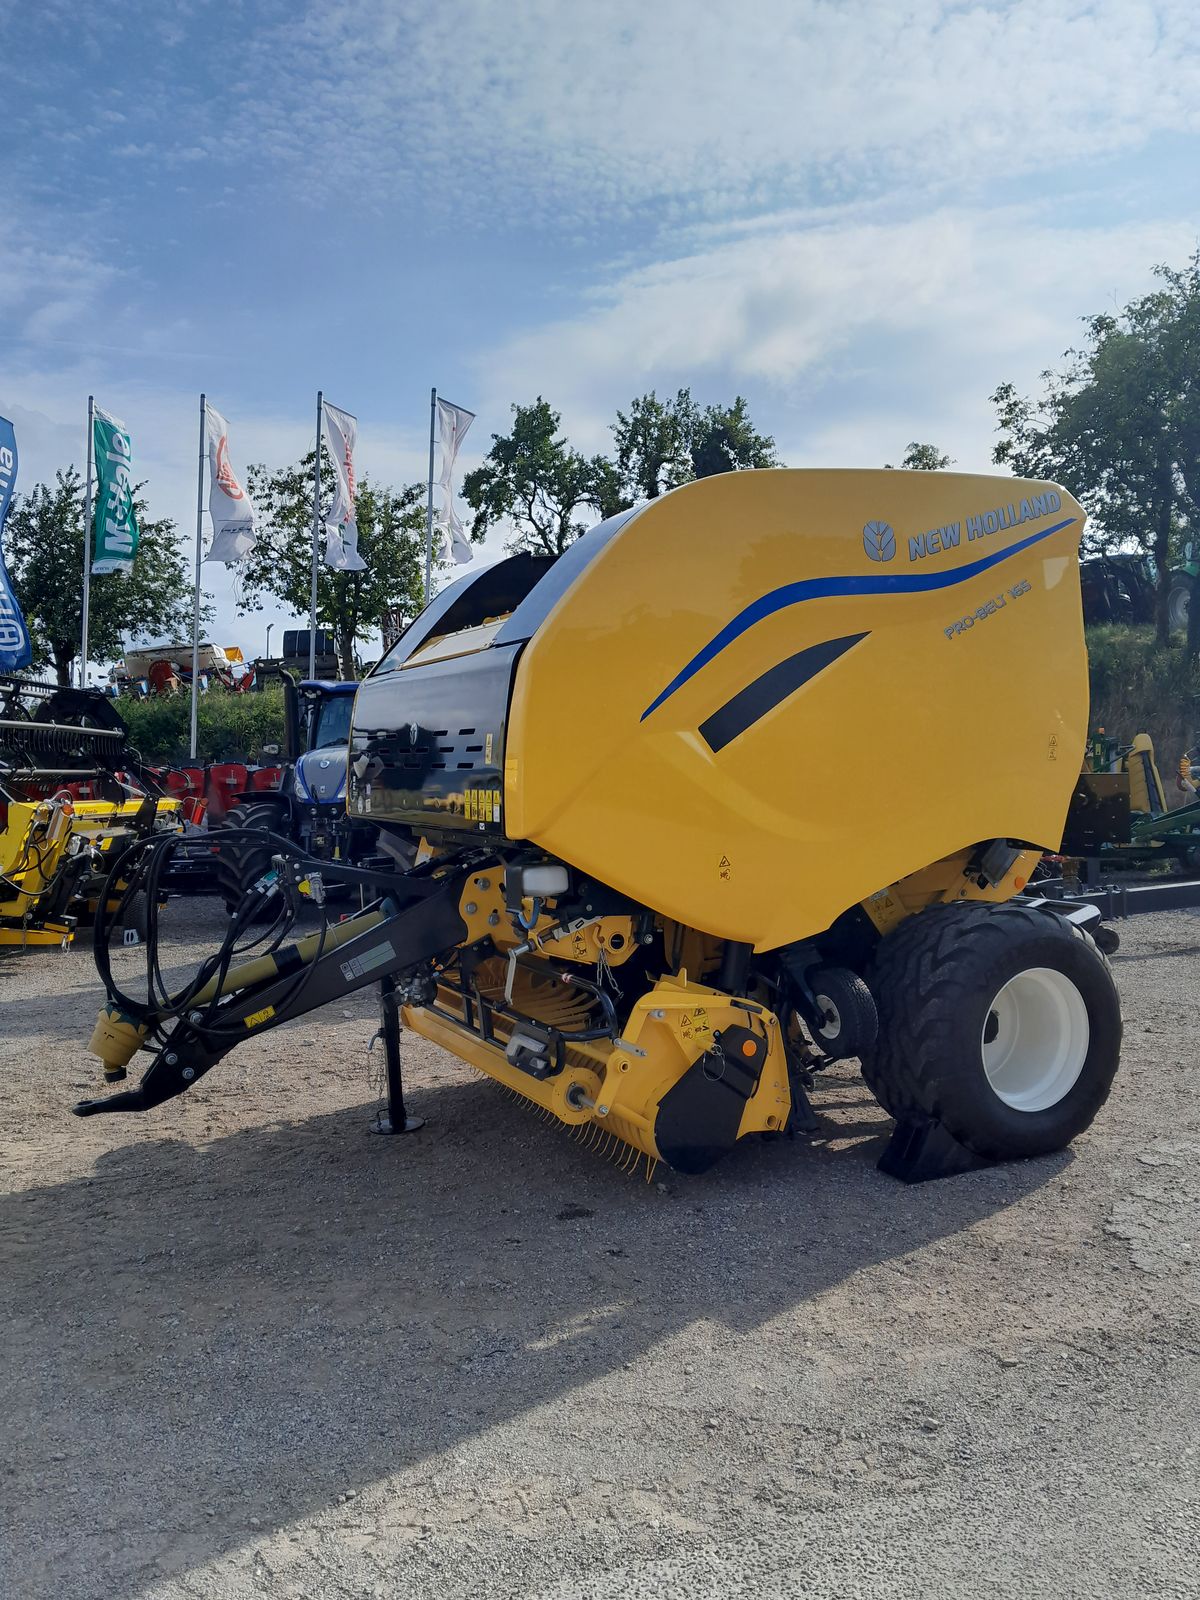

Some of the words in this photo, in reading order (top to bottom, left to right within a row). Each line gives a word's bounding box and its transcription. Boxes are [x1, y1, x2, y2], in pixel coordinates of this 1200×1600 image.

[908, 521, 961, 562] NEW
[966, 490, 1062, 542] HOLLAND
[944, 594, 1007, 640] PRO-BELT
[1007, 579, 1032, 600] 165
